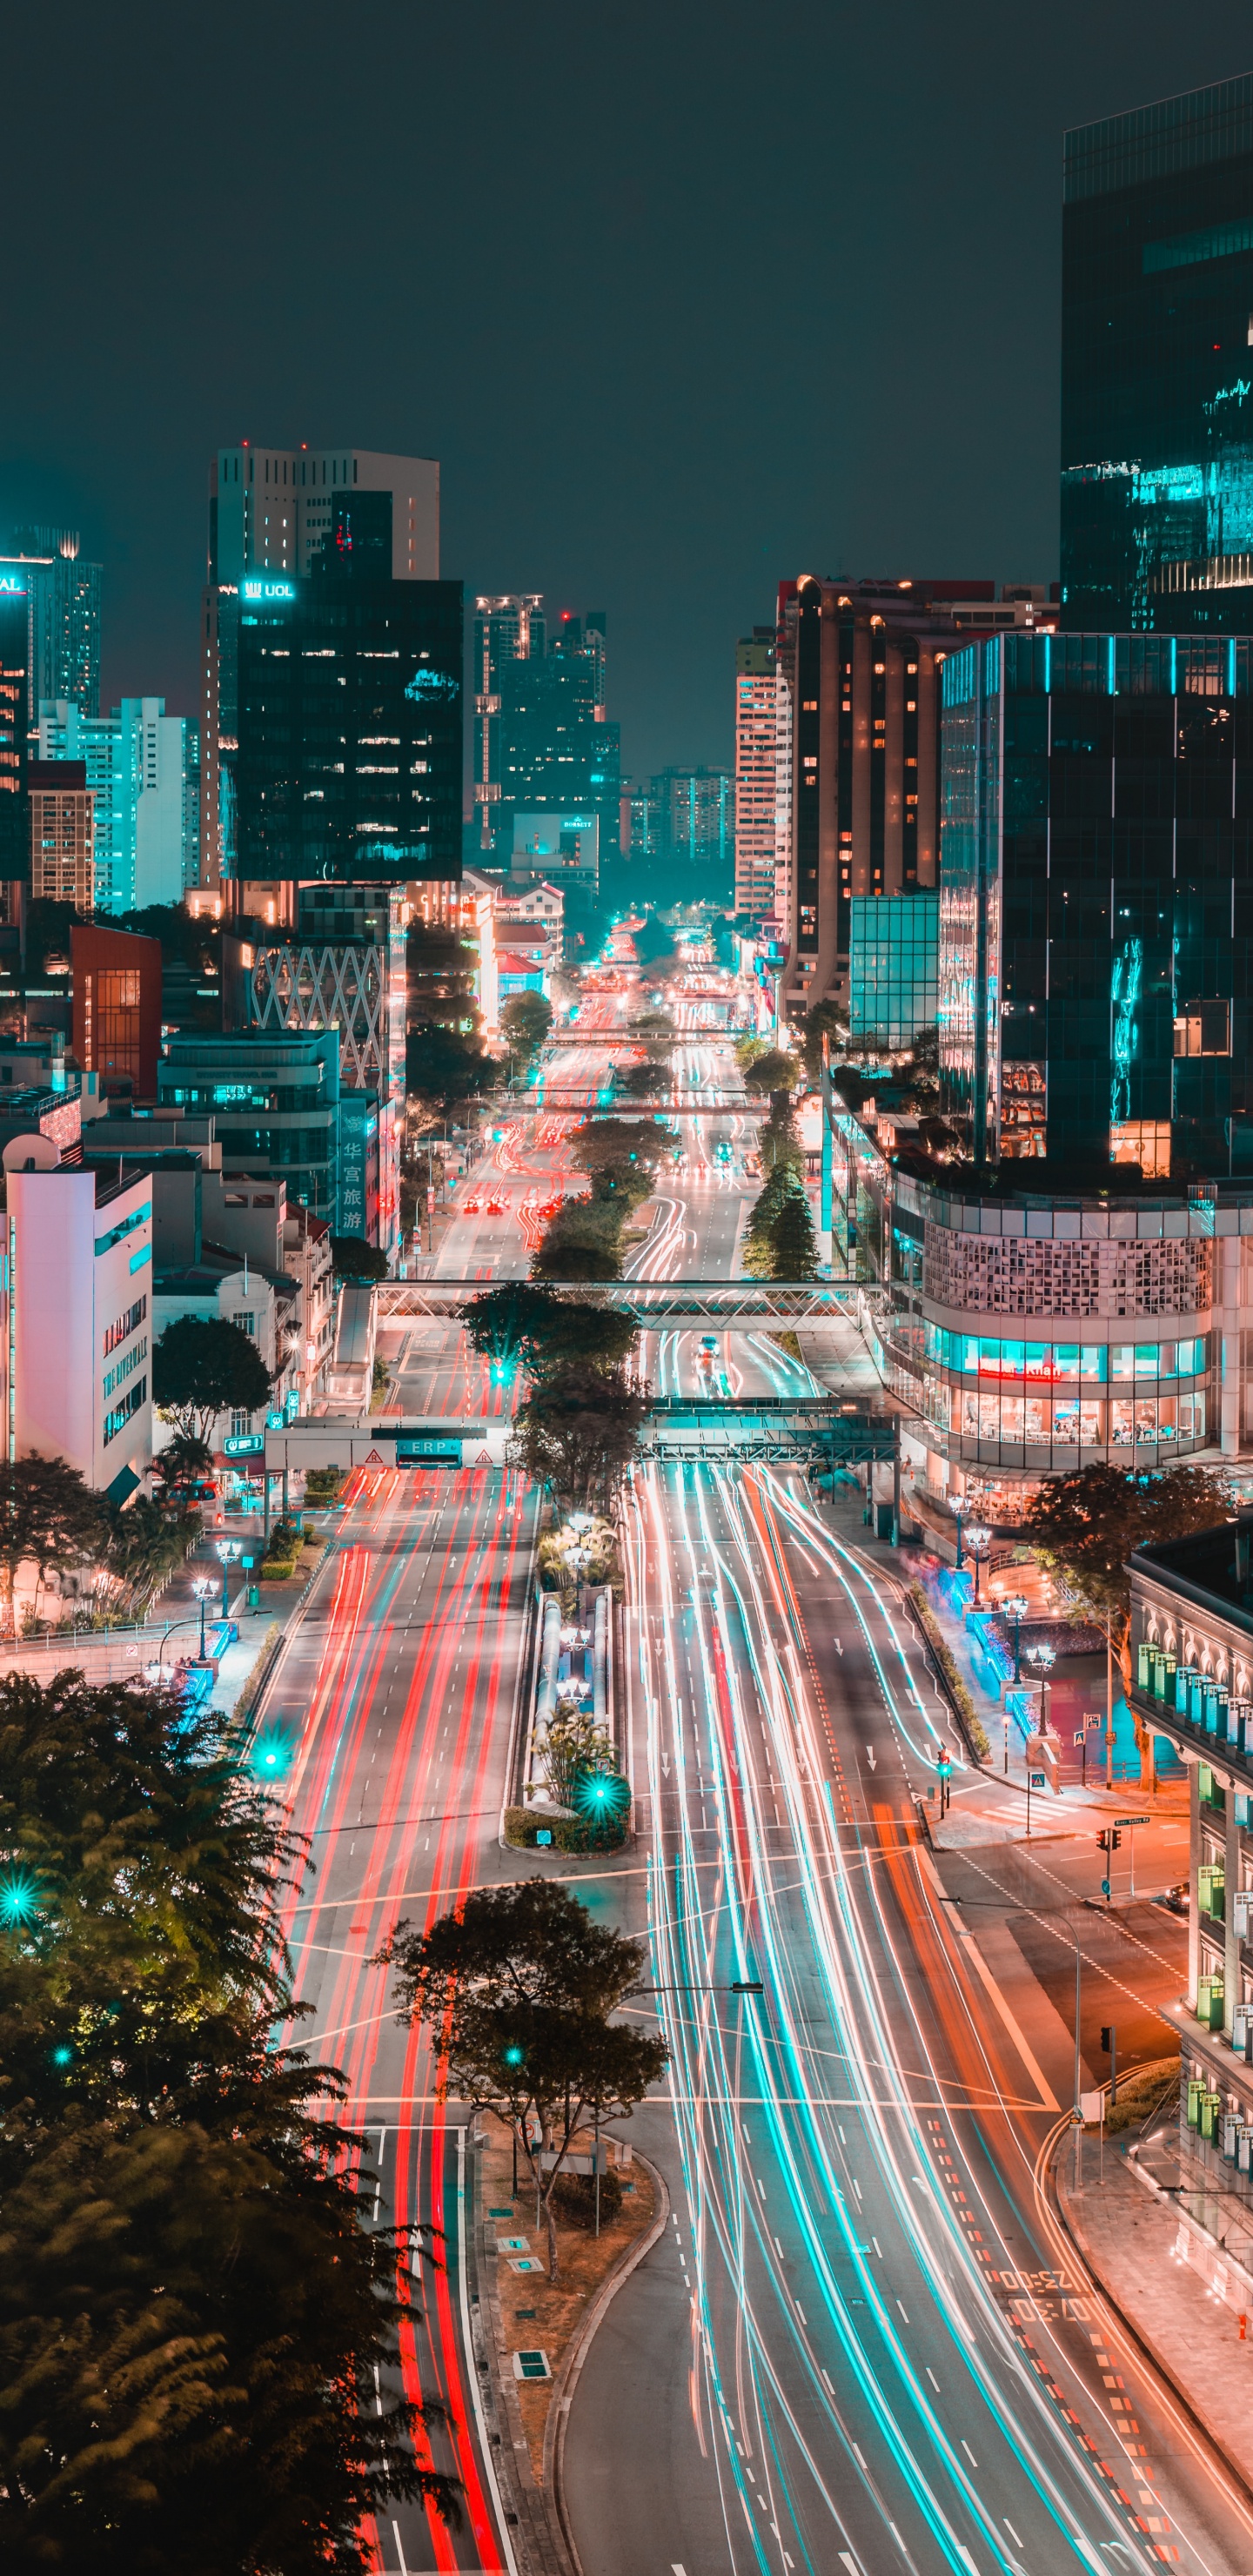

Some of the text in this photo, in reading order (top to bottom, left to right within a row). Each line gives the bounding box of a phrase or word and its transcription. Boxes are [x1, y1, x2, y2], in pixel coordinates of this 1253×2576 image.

[265, 585, 293, 597] UOL
[343, 1143, 362, 1229] 华宫旅游
[103, 1335, 148, 1401] THE RIVERWALK
[1026, 1362, 1061, 1377] Khan
[412, 1442, 446, 1453] ERP
